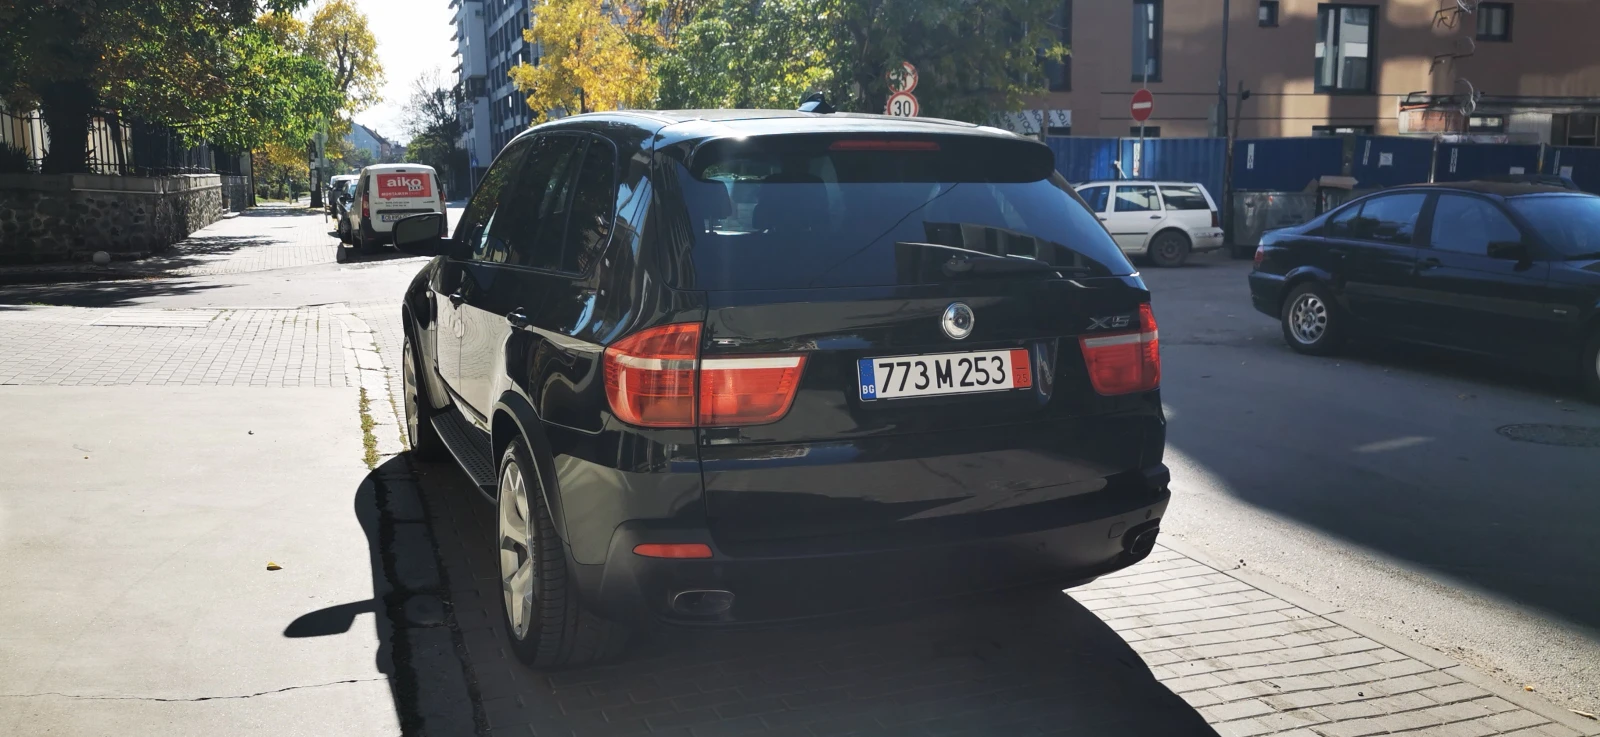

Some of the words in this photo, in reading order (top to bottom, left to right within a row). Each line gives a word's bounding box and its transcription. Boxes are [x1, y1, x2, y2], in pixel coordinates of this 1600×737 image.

[894, 100, 911, 117] 30
[386, 176, 422, 187] aiko
[1086, 315, 1131, 331] X5
[878, 361, 930, 393] 773
[934, 359, 954, 389] M
[957, 356, 1006, 388] 253
[1016, 374, 1028, 384] 25
[862, 385, 875, 395] BG
